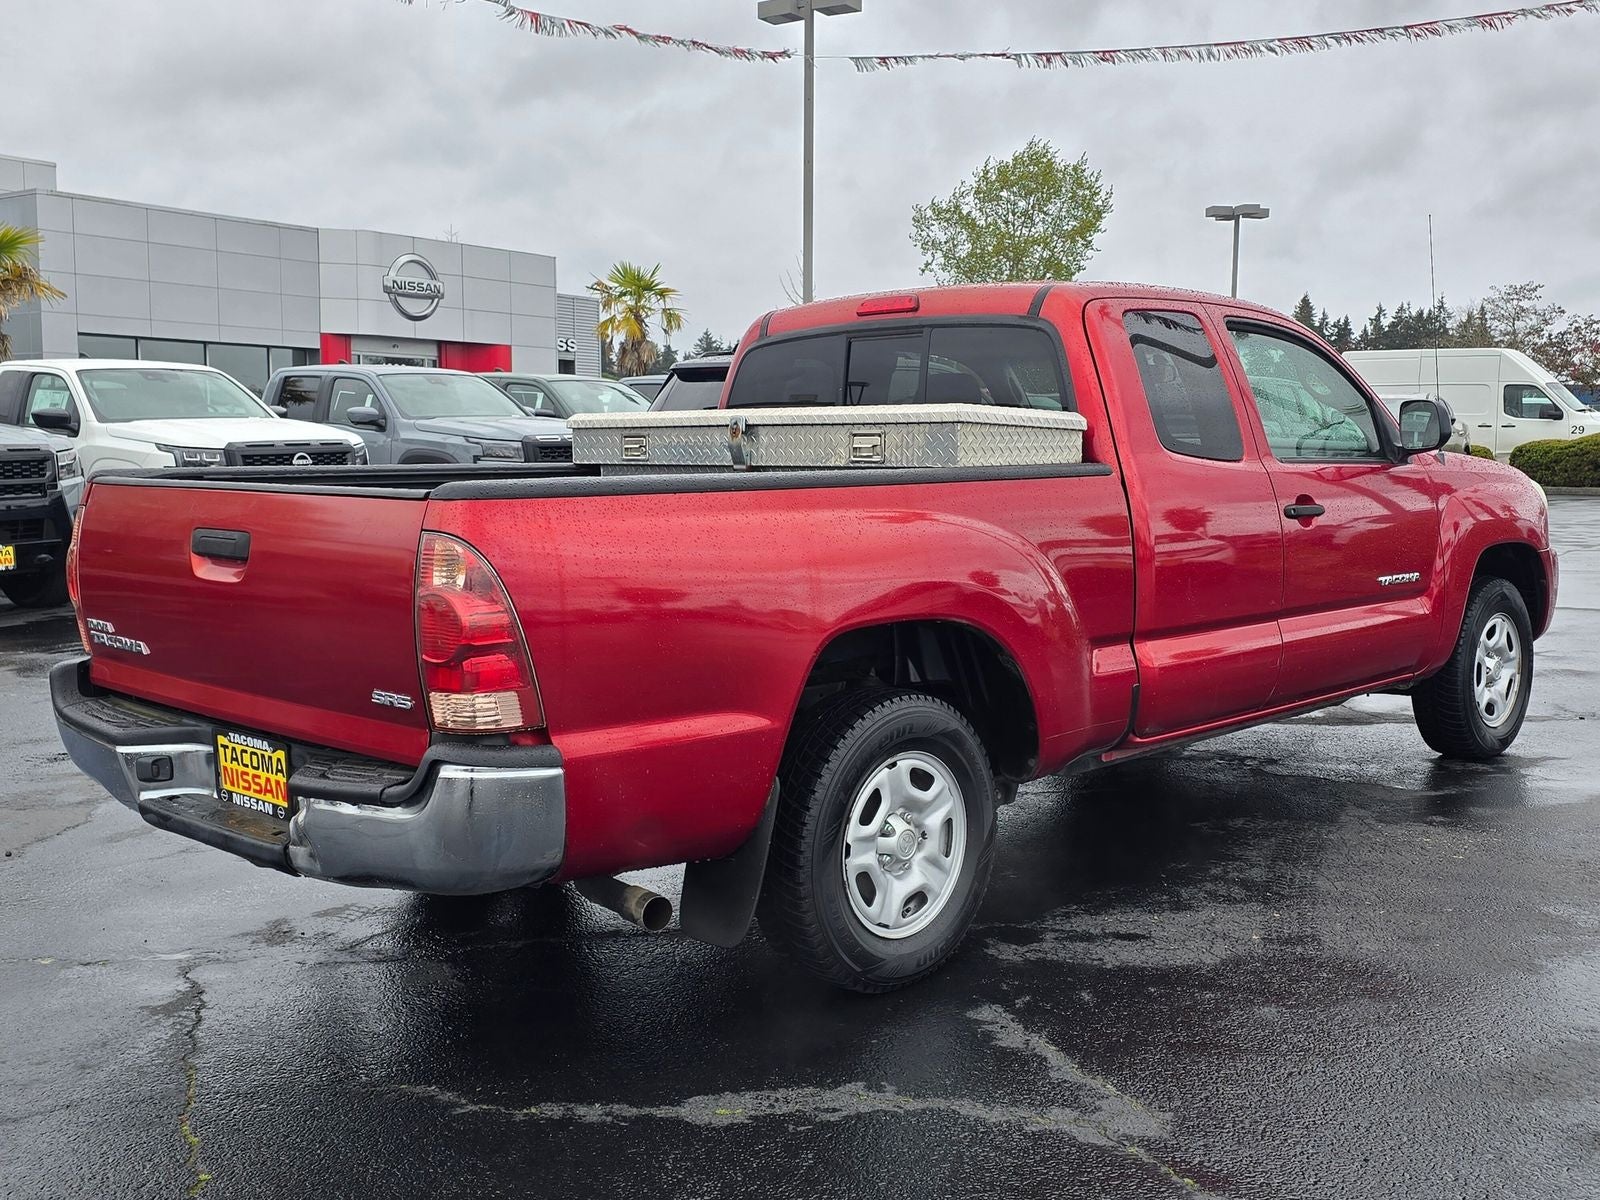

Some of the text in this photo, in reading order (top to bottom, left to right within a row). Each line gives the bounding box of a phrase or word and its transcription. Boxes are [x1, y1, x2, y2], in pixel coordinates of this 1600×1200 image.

[392, 280, 441, 294] NISSAN
[1571, 425, 1585, 435] 29
[228, 732, 270, 752] TACOMA
[220, 743, 286, 778] TACOMA
[222, 765, 288, 803] NISSAN
[232, 792, 274, 816] NISSAN
